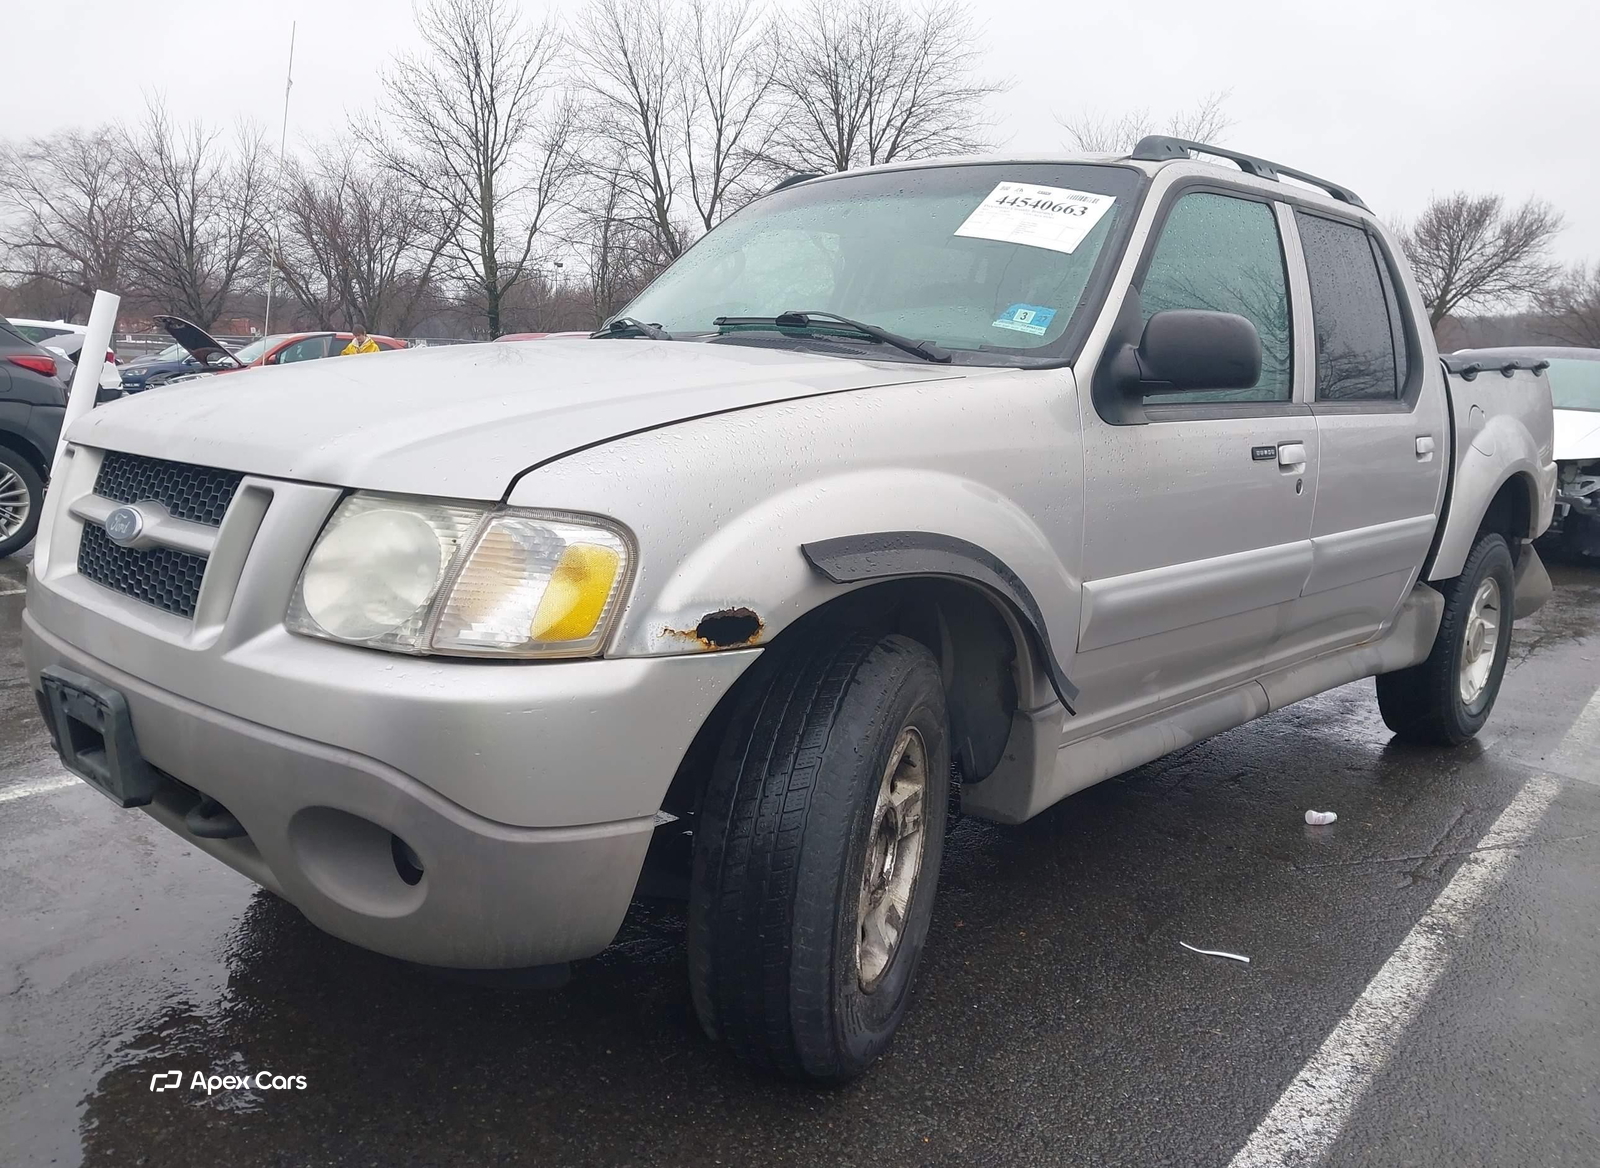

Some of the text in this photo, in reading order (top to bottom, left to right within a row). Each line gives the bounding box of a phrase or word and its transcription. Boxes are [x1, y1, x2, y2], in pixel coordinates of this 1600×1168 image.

[996, 195, 1088, 217] 44540663
[1020, 312, 1028, 320] 3
[110, 512, 131, 534] Ford
